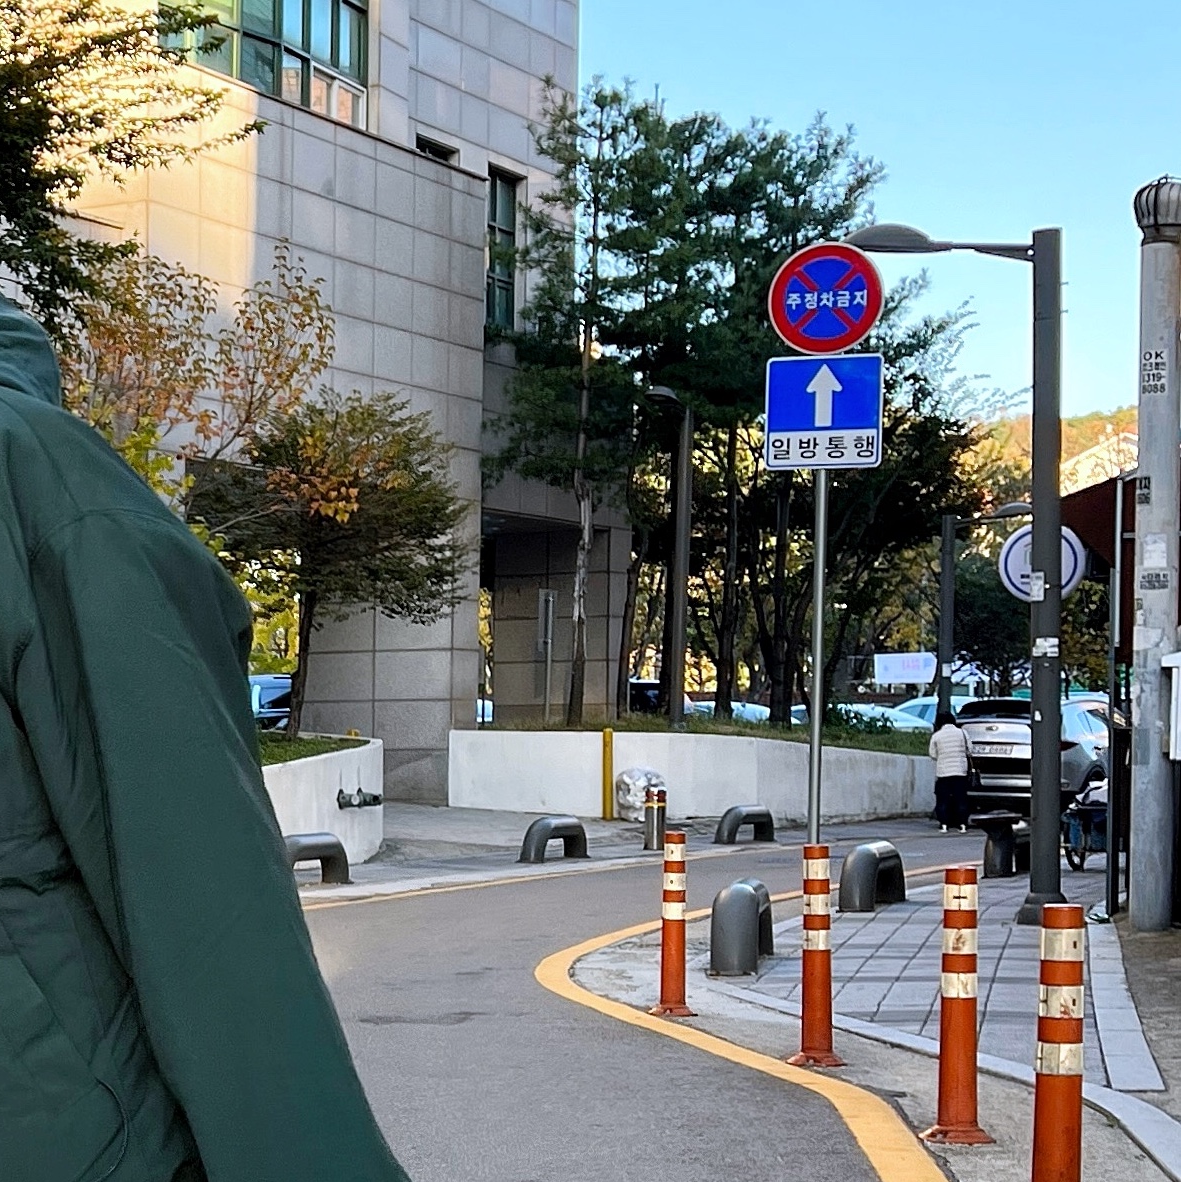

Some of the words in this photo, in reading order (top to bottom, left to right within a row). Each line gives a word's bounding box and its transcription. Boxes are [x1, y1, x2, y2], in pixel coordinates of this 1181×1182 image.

[786, 289, 868, 310] 주정차금지
[1143, 350, 1164, 361] OK
[771, 434, 875, 460] 일방통행
